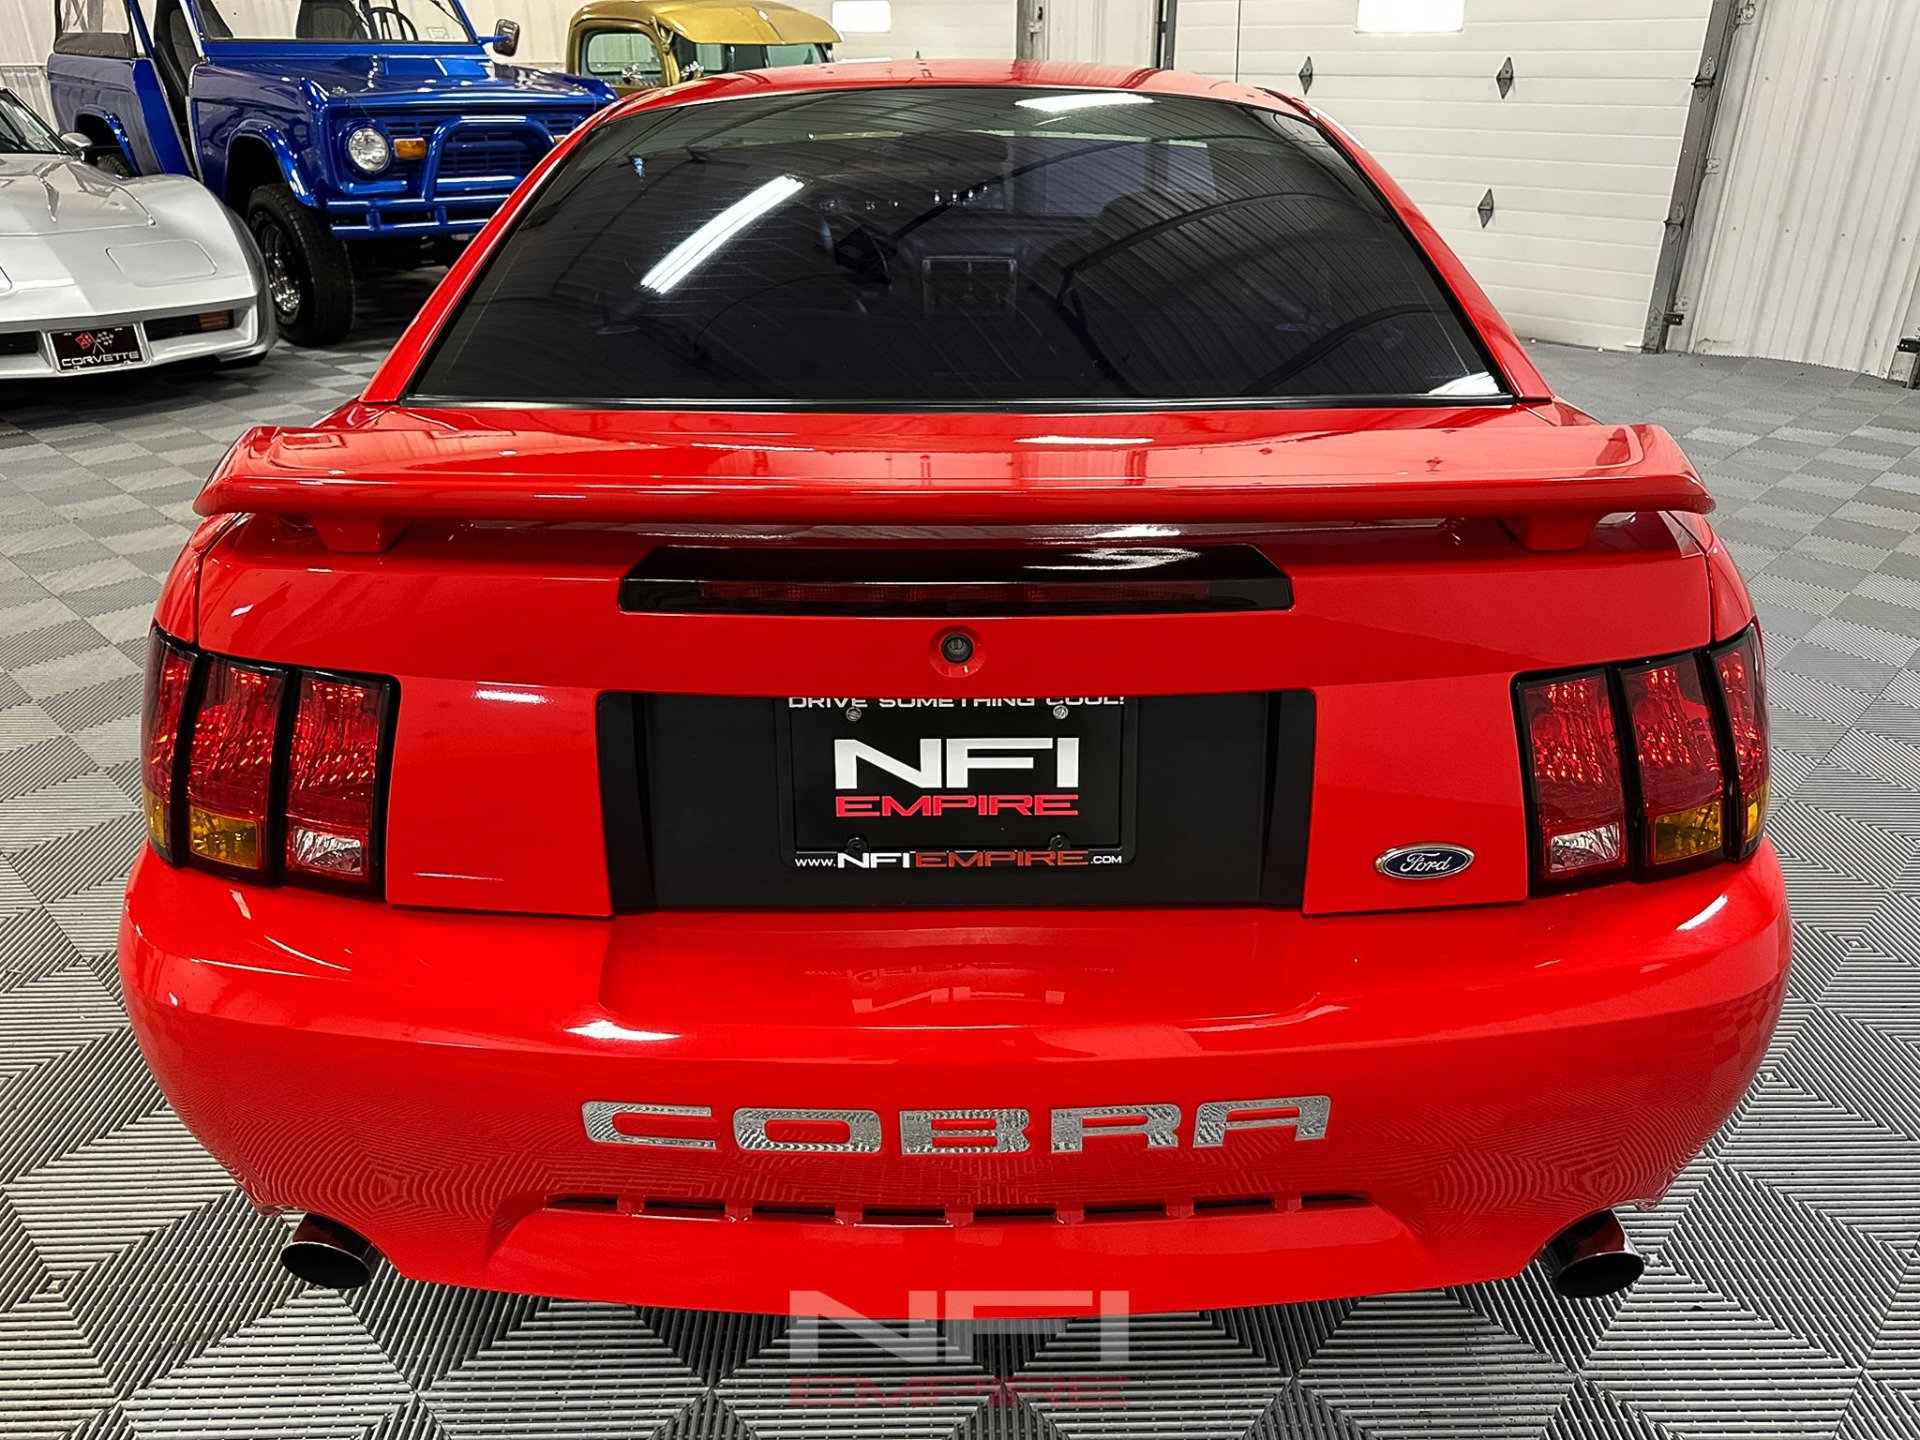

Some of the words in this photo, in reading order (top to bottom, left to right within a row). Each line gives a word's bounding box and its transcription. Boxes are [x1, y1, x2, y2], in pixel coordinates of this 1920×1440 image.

[61, 351, 139, 367] CORVETTE
[788, 697, 868, 708] DRIVE
[834, 737, 1079, 789] NFI
[835, 794, 1079, 817] EMPIRE
[1400, 852, 1453, 872] Ford
[582, 1095, 1330, 1155] COBRA
